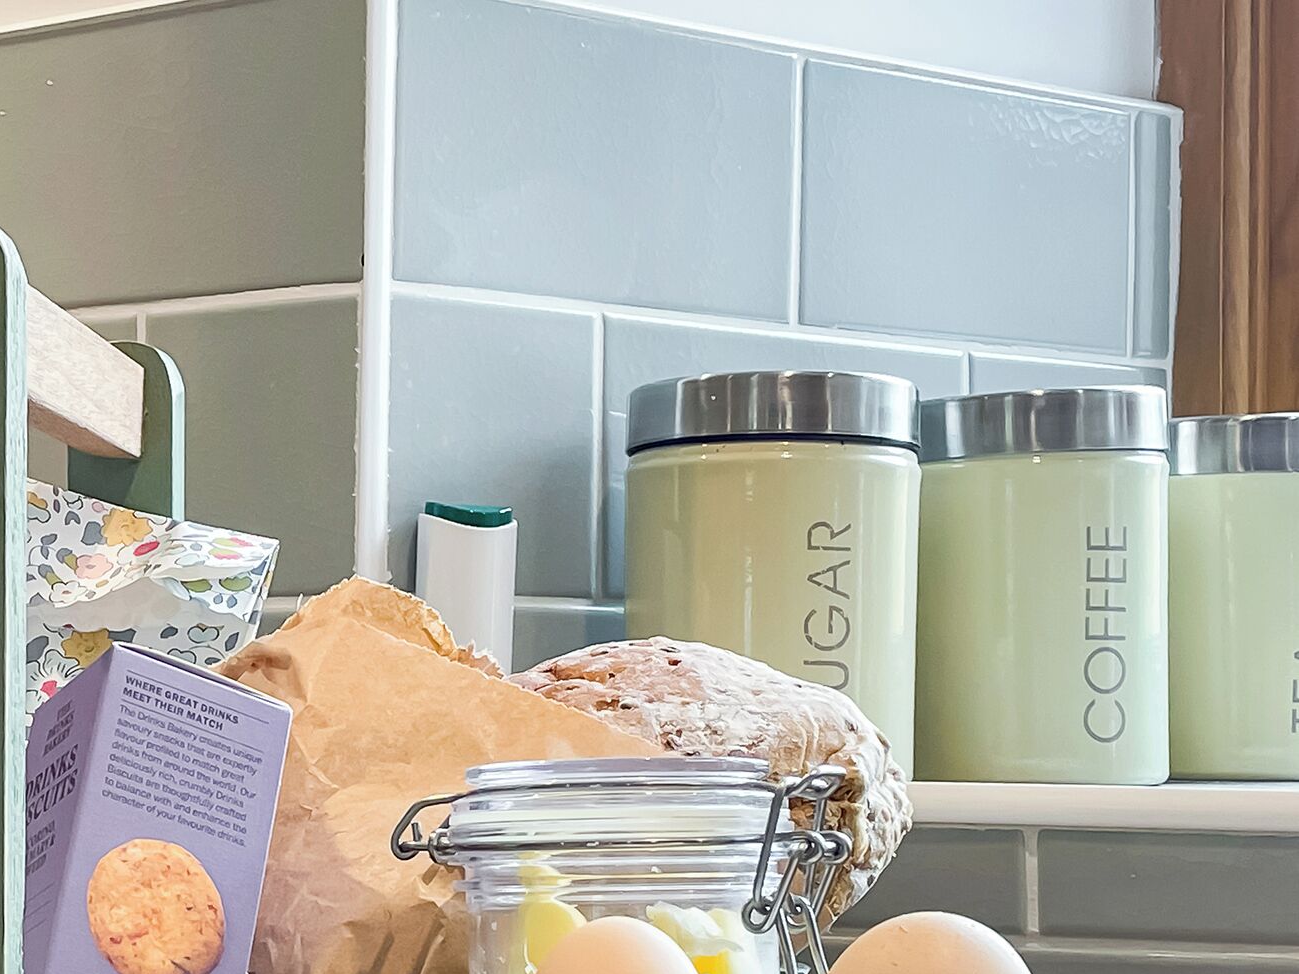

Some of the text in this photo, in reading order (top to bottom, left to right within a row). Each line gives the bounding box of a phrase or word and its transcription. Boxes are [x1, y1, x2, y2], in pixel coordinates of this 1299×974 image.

[803, 520, 852, 690] UGAR
[1084, 524, 1129, 744] COFFEE
[123, 687, 223, 731] MEET THEIR MATCH
[125, 675, 239, 724] WHERE GREAT DRINKS
[114, 728, 145, 746] flavour
[181, 752, 191, 763] to
[192, 758, 220, 774] match
[221, 769, 245, 786] great
[117, 718, 152, 737] savoury
[207, 750, 221, 762] are
[120, 704, 136, 717] The
[137, 710, 165, 729] Drinks
[167, 723, 197, 741] Bakery
[233, 748, 263, 766] unique
[26, 744, 78, 799] DRINKS
[26, 768, 78, 826] SCUITS
[107, 764, 143, 784] Biscuits
[145, 779, 161, 790] are
[215, 804, 247, 822] crafted
[109, 754, 157, 777] deliciously
[179, 779, 214, 799] crumbly
[215, 791, 244, 808] Drinks
[112, 741, 139, 758] drinks
[141, 751, 162, 766] from
[164, 760, 195, 778] around
[196, 771, 211, 784] the
[240, 787, 256, 800] Our
[102, 788, 145, 809] character
[146, 804, 156, 814] of
[157, 808, 176, 822] your
[104, 776, 114, 787] to
[115, 780, 151, 799] balance
[153, 795, 172, 809] with
[173, 802, 190, 814] and
[192, 809, 230, 828] enhance
